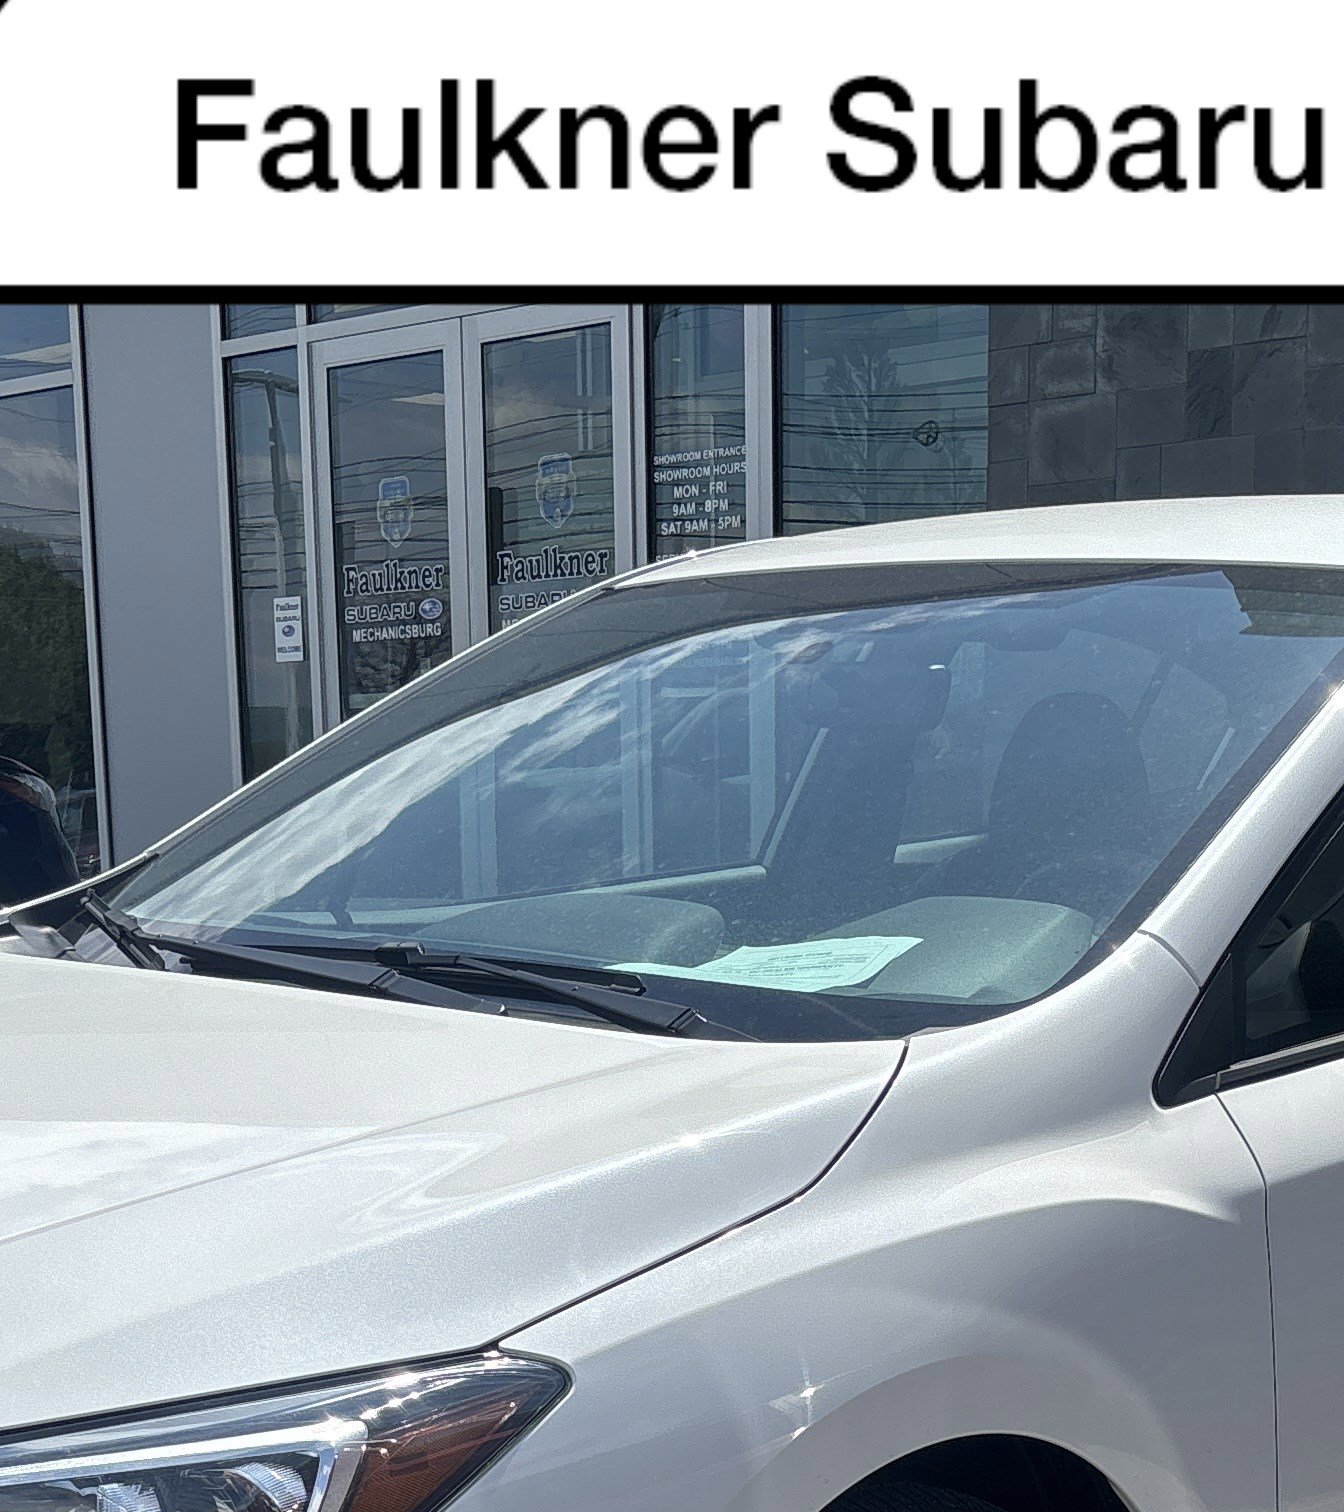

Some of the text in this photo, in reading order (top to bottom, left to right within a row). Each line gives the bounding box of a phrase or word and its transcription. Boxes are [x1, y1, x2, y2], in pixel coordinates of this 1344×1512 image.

[653, 445, 747, 466] SHOWROOM ENTRANCE
[653, 461, 747, 483] SHOWROOM HOURS
[673, 484, 700, 499] MON
[709, 480, 728, 495] FRI
[672, 501, 696, 517] 9AM
[704, 499, 729, 513] 8PM
[661, 521, 683, 536] SAT
[684, 518, 708, 533] 9AM
[717, 514, 741, 530] 5PM
[496, 546, 609, 584] Faulkner
[343, 560, 444, 597] Faulkner
[345, 602, 416, 624] SUBARU
[352, 622, 442, 643] MECHANICSBURG
